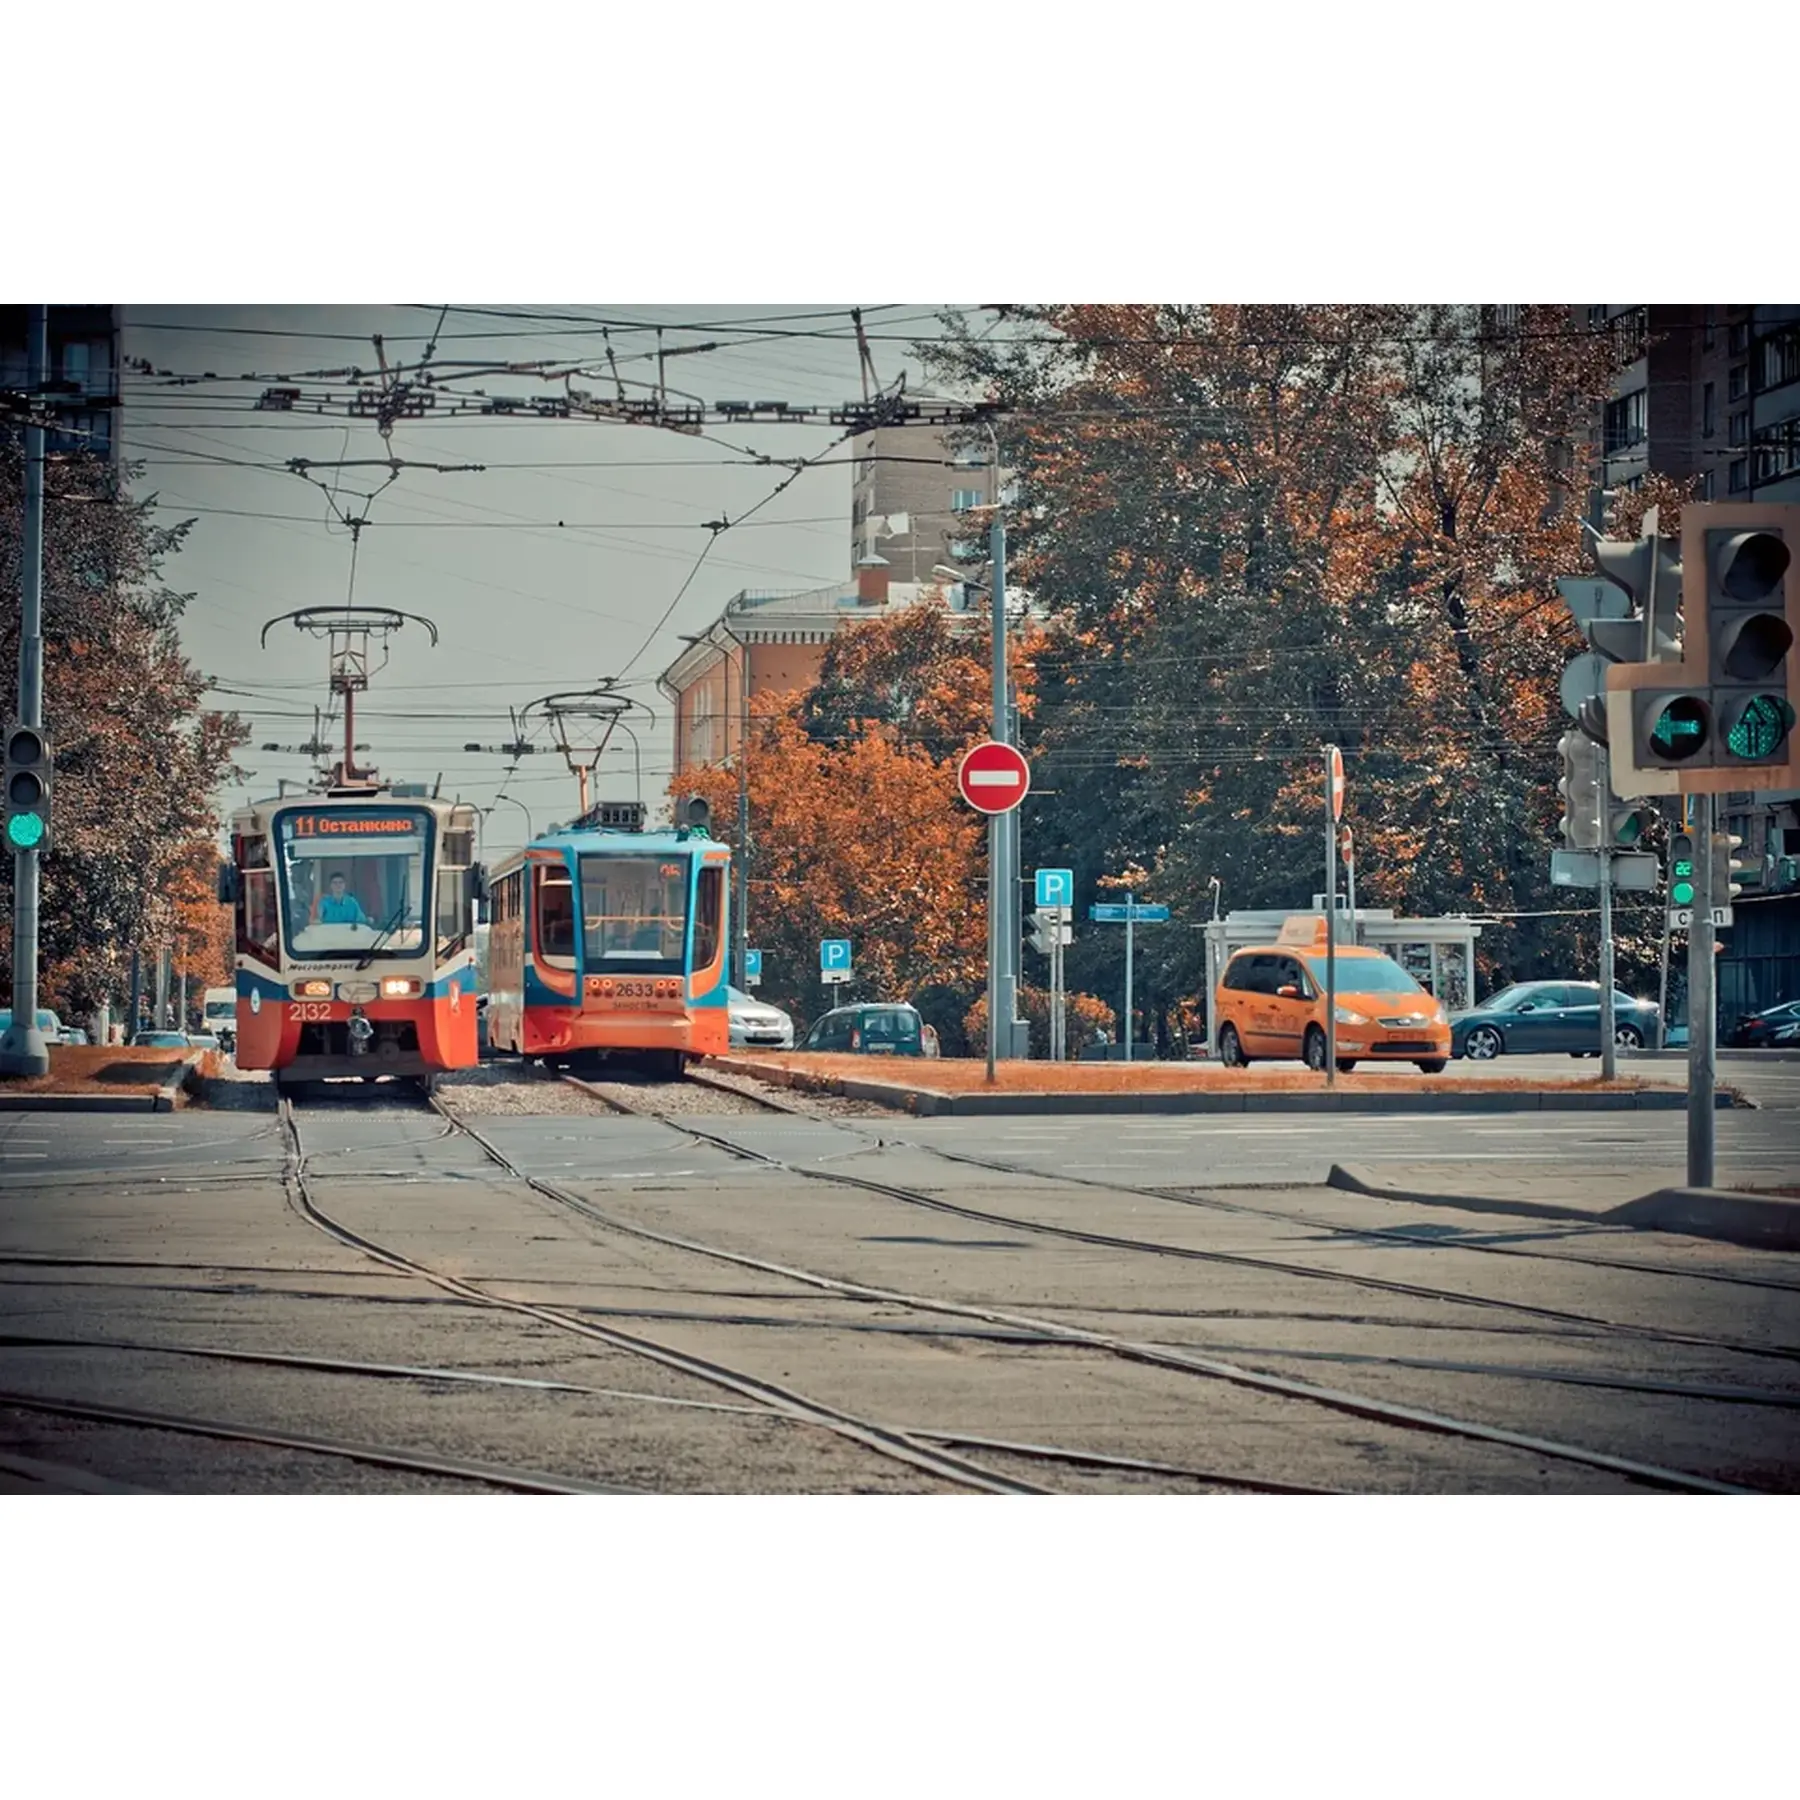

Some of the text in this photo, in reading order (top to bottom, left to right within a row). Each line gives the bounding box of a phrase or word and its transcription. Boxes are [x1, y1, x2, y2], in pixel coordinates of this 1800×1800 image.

[296, 816, 412, 836] 11 Останкино
[1045, 874, 1064, 902] P
[828, 944, 844, 967] P
[616, 982, 654, 998] 2633
[289, 1003, 333, 1021] 2132
